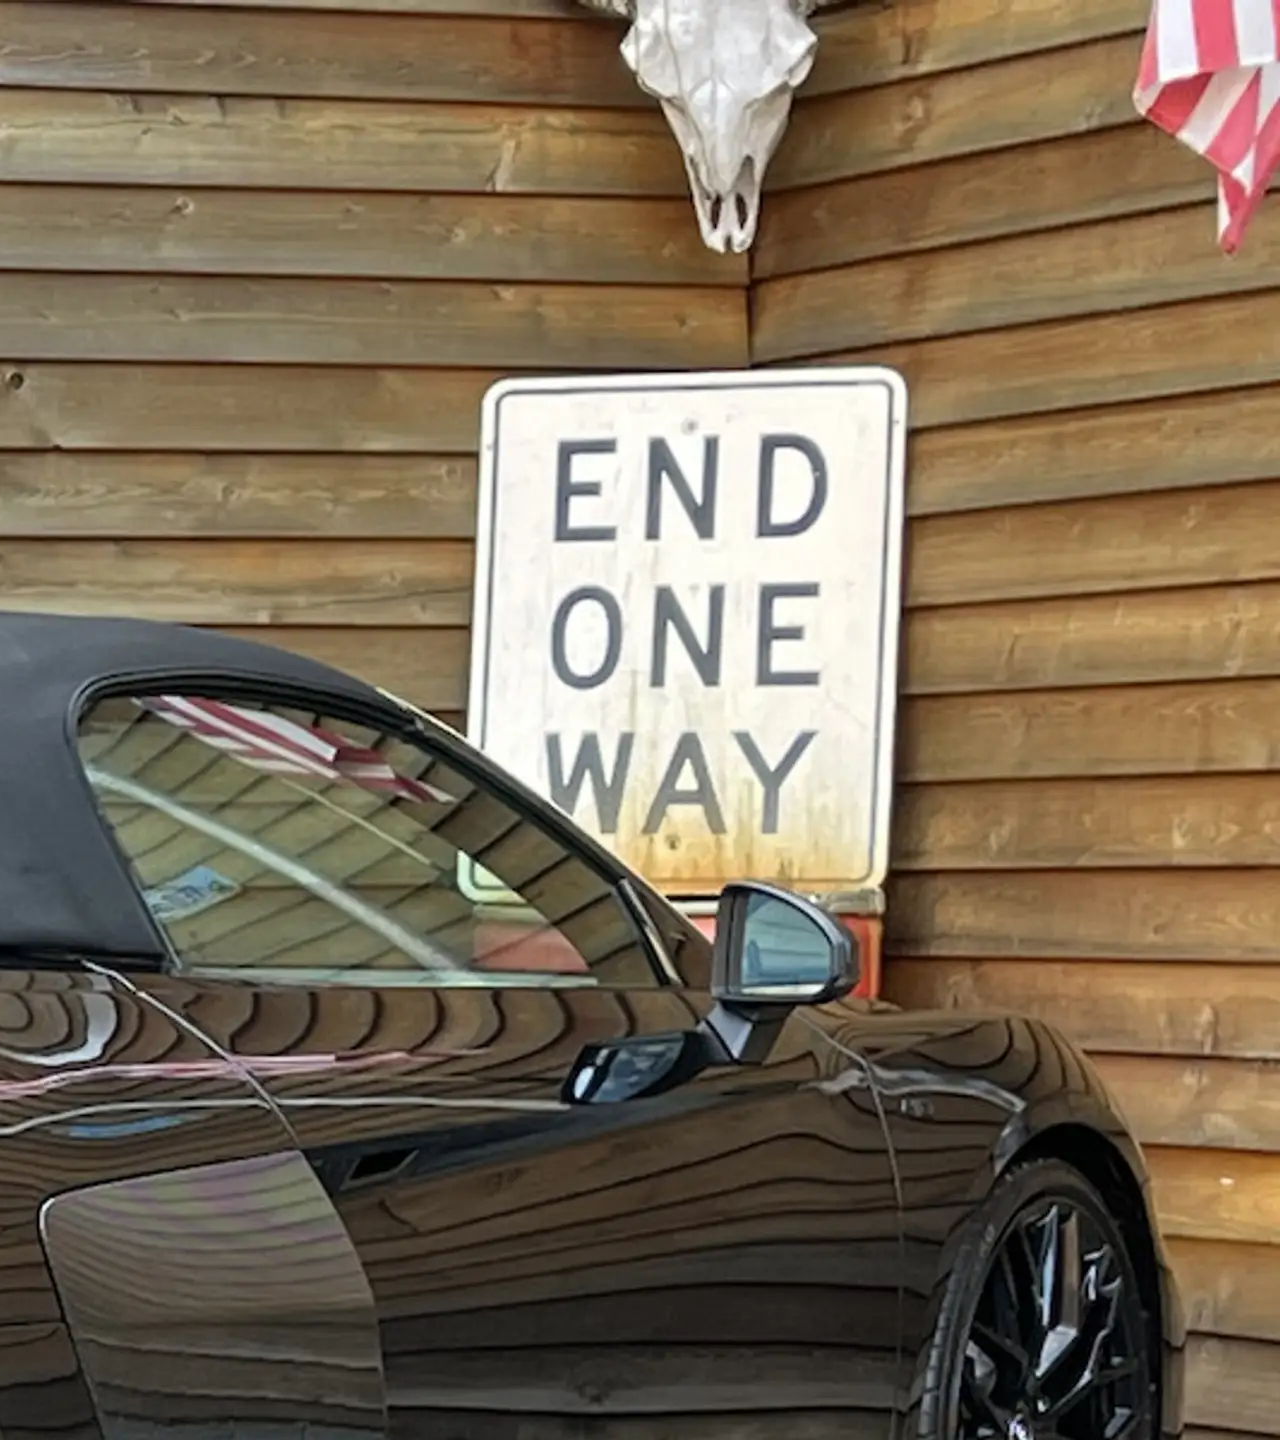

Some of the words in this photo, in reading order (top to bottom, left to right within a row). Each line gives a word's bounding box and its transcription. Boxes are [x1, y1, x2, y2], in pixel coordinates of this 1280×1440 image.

[553, 432, 829, 543] END
[550, 581, 822, 691] ONE
[544, 730, 820, 835] WAY
